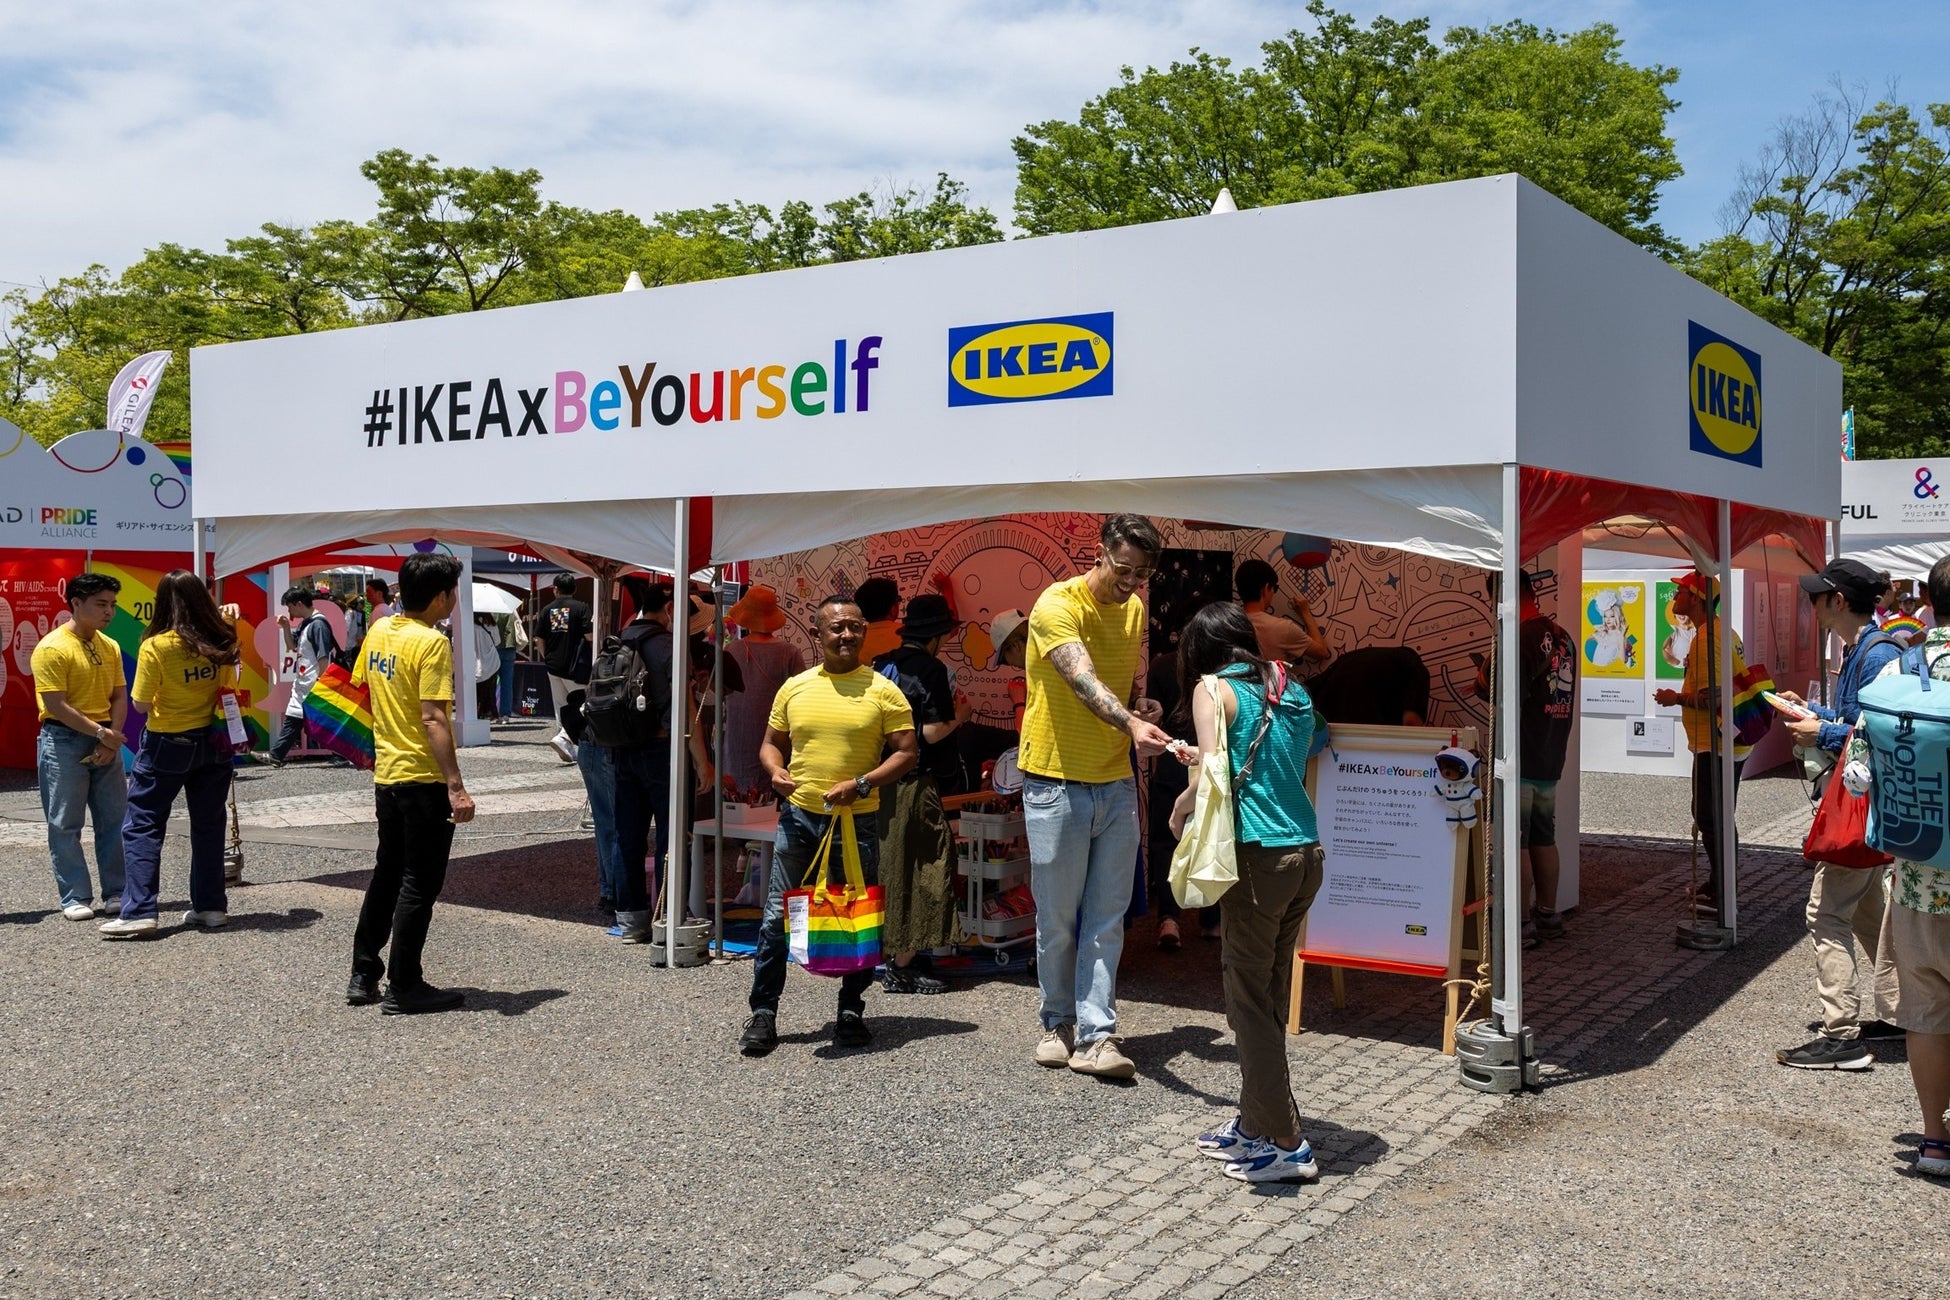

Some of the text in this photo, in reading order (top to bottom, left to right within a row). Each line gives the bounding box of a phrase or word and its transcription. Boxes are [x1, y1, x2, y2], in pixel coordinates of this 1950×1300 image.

[965, 339, 1099, 380] IKEA
[363, 335, 883, 447] #IKEAxBeYourself
[1697, 363, 1757, 430] IKEA
[41, 507, 98, 526] PRIDE
[1841, 505, 1878, 520] FUL
[41, 527, 98, 538] ALLIANCE
[369, 651, 396, 680] Hej!
[1338, 763, 1438, 778] #IKEAxBeYourself
[1877, 747, 1899, 816] FACE
[1894, 724, 1921, 820] NORTH
[1336, 785, 1370, 793] じぶんだけの
[1918, 772, 1943, 824] THE
[1407, 926, 1426, 935] IKEA
